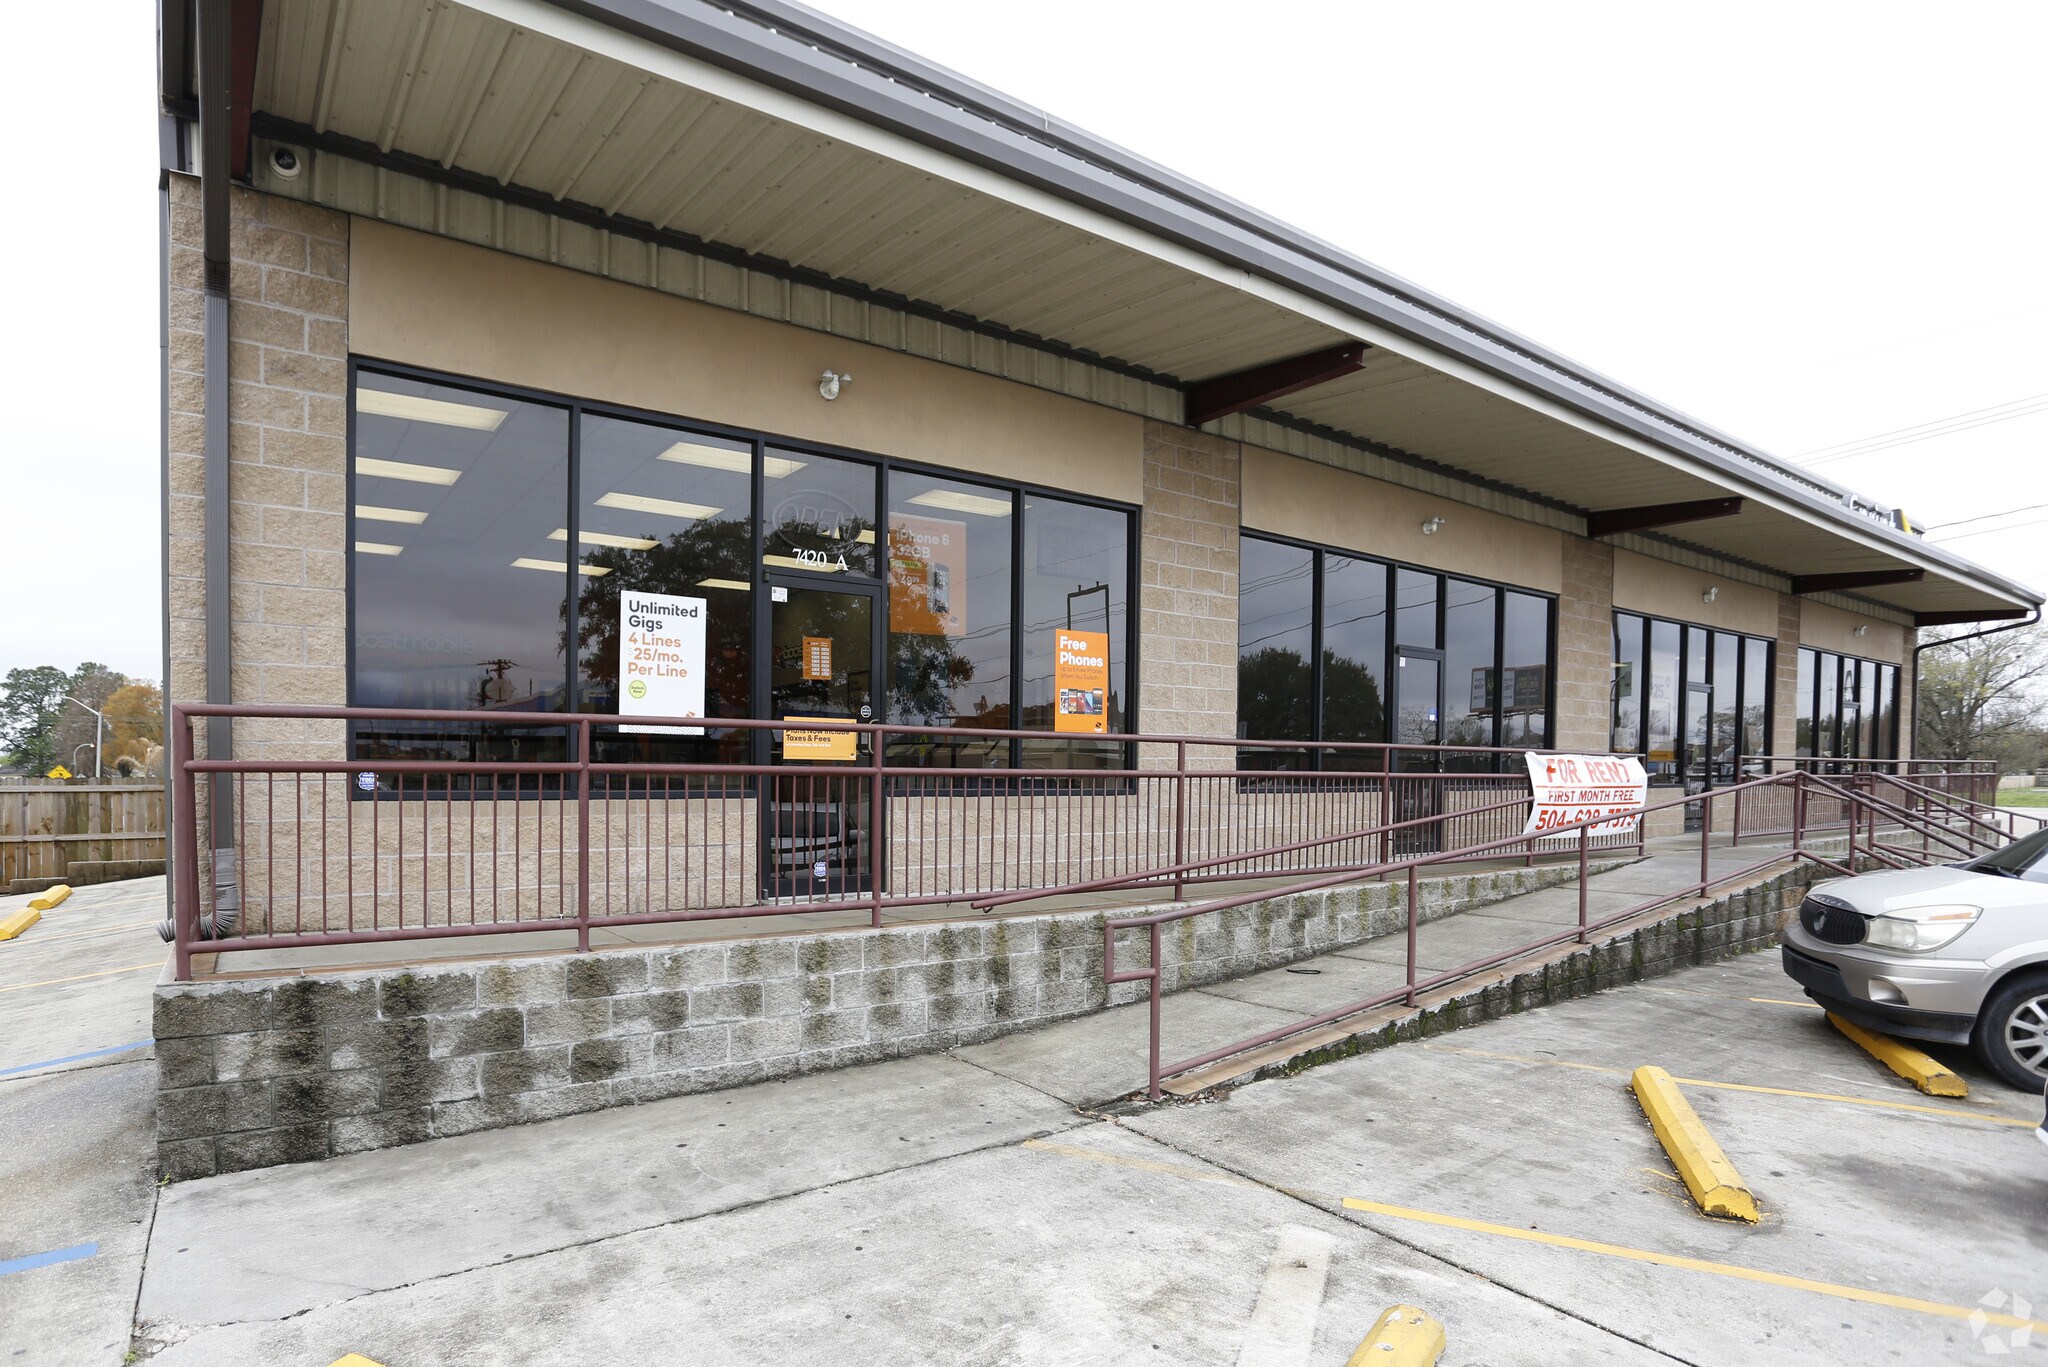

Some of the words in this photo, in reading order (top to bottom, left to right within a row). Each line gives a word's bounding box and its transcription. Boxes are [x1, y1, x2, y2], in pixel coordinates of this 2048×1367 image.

[896, 528, 939, 545] iPhone
[792, 547, 827, 568] 7420
[835, 554, 849, 571] A
[629, 600, 698, 618] Unlimited
[628, 615, 663, 633] Gigs
[628, 632, 639, 645] 4
[641, 632, 682, 648] Lines
[1060, 635, 1087, 651] Free
[627, 647, 684, 663] $25/mo.
[1060, 651, 1104, 668] Phones
[627, 662, 653, 676] Per
[656, 664, 688, 678] Line
[786, 734, 807, 742] Taxes
[814, 735, 831, 743] Fees
[1546, 758, 1582, 784] FOR
[1584, 760, 1632, 784] RENT
[1548, 789, 1576, 803] FIRST
[1578, 789, 1609, 803] MONTH
[1613, 790, 1635, 801] FREE
